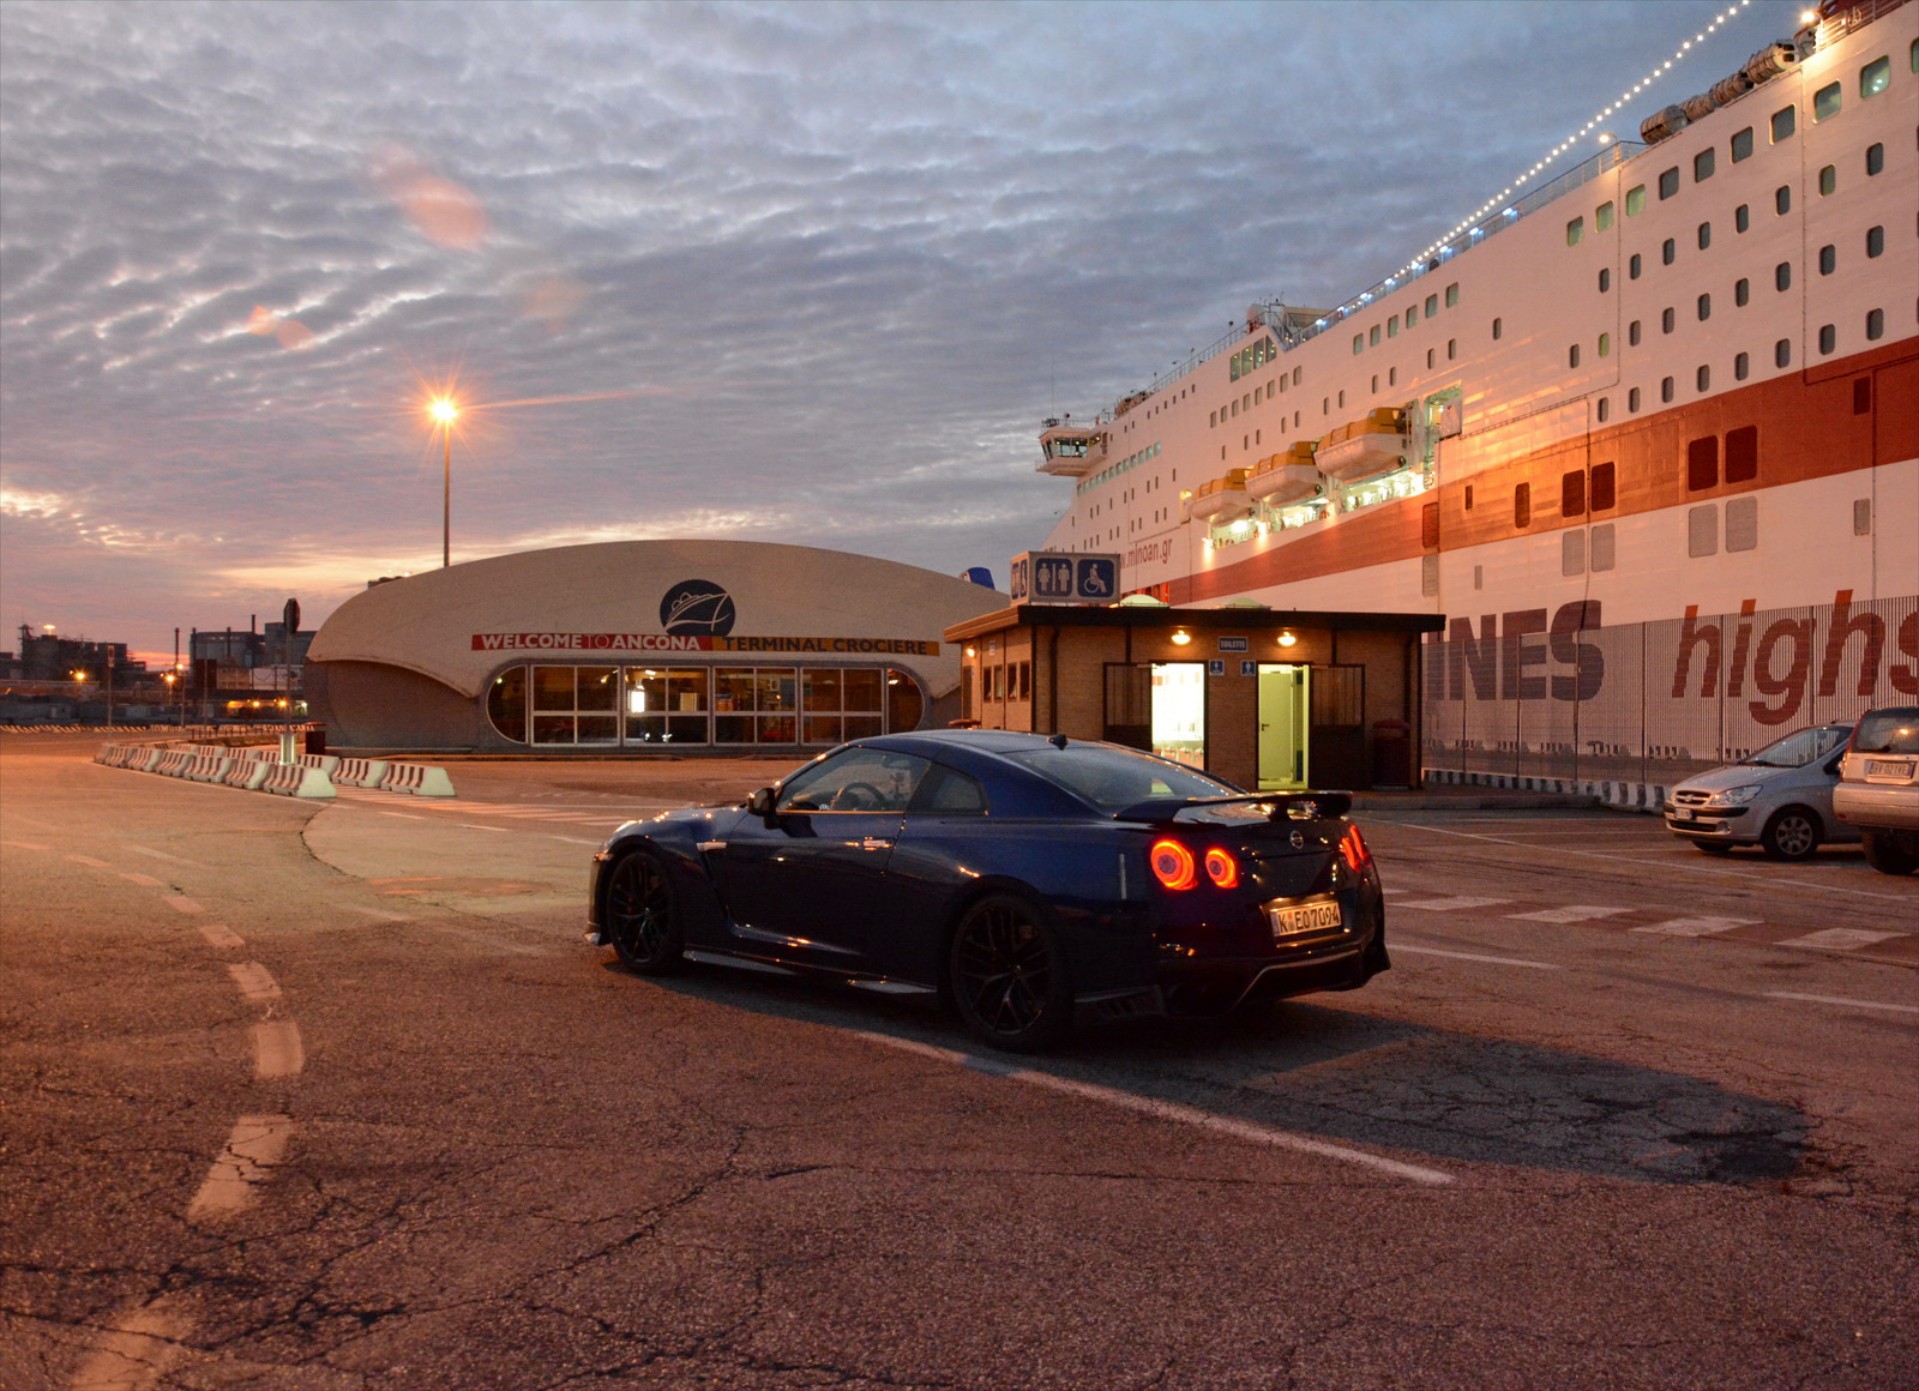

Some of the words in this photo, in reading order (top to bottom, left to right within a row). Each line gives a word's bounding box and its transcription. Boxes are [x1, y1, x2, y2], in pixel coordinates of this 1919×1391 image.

[481, 633, 582, 649] WELCOME
[583, 634, 609, 649] TO
[611, 634, 701, 650] ANCONA
[723, 636, 829, 652] TERMINAL
[832, 638, 928, 655] CROCIERE
